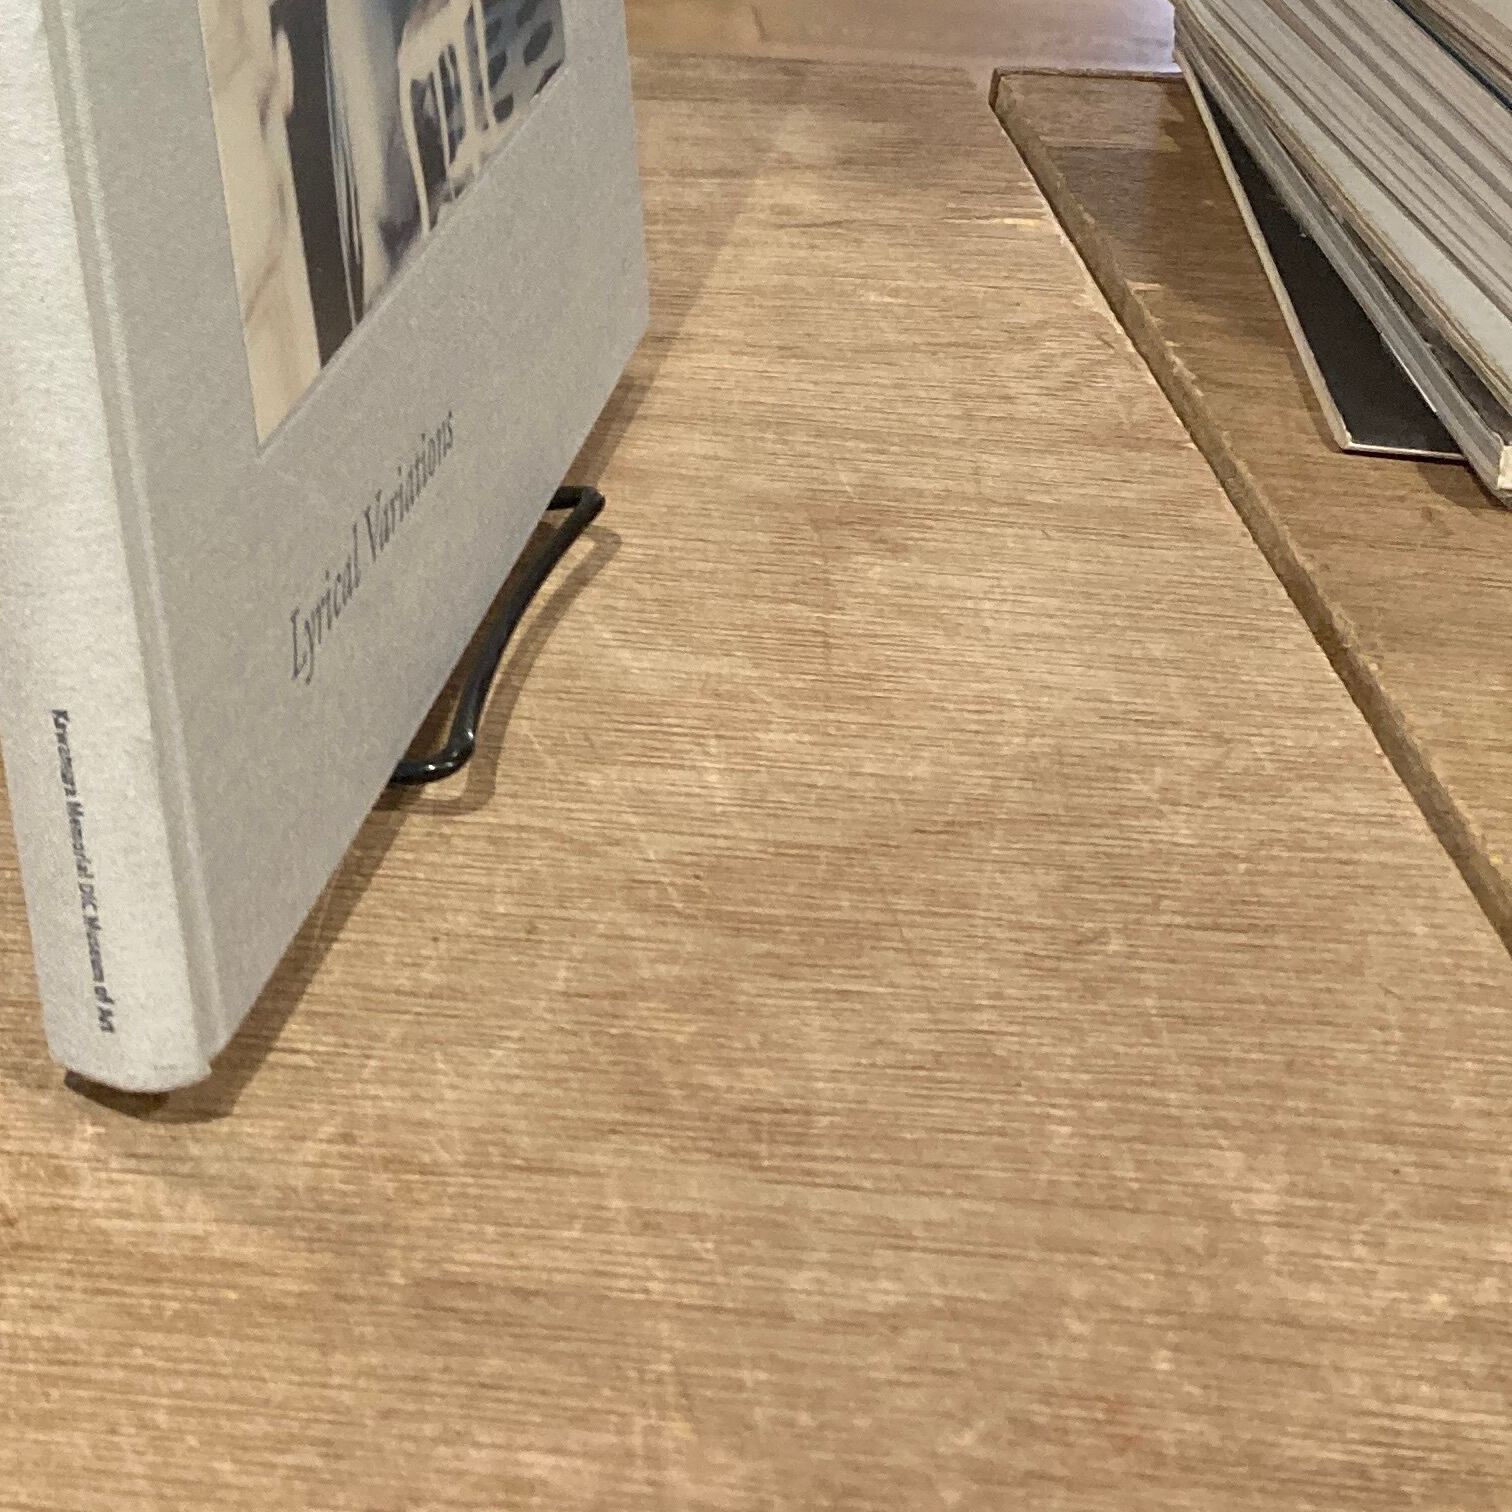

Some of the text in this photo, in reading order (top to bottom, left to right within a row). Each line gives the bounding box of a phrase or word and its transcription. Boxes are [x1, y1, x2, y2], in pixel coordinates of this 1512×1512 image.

[290, 409, 454, 686] Lyrical Variations
[77, 882, 98, 913] DIC
[83, 915, 105, 983] Museum
[94, 985, 115, 1005] of
[96, 1006, 116, 1034] Art
